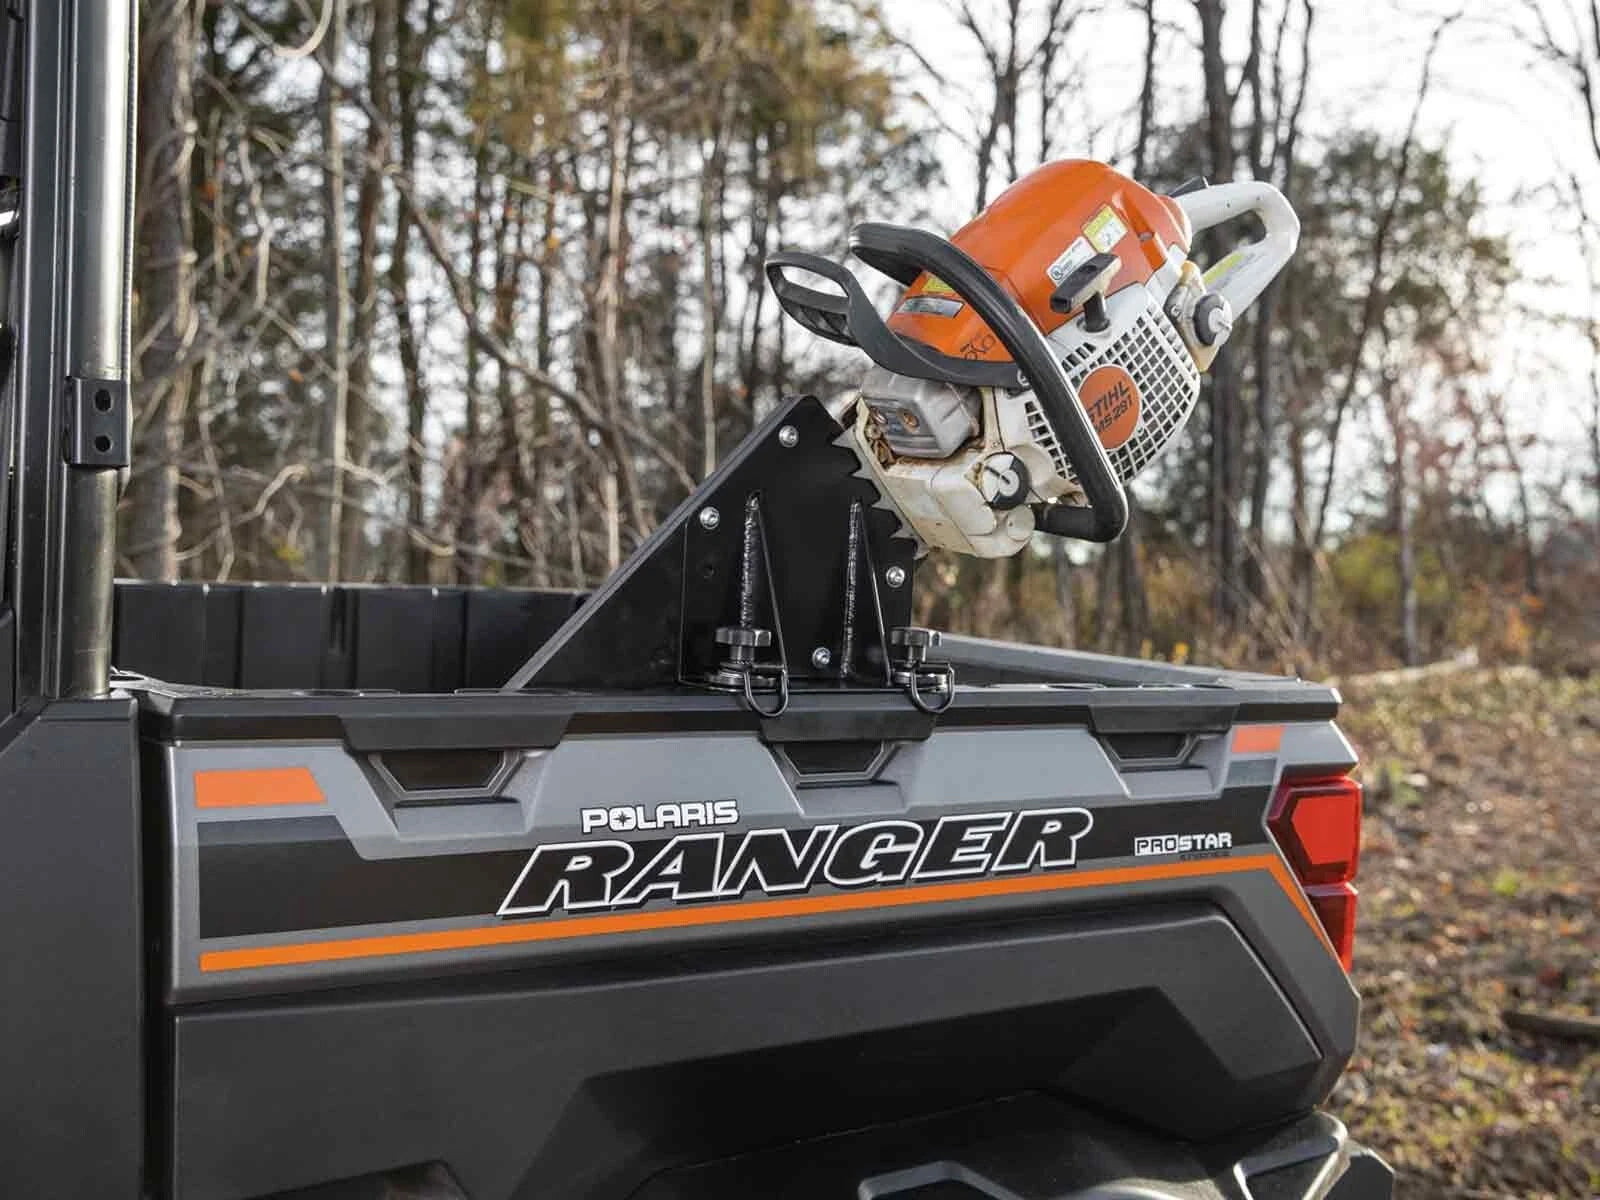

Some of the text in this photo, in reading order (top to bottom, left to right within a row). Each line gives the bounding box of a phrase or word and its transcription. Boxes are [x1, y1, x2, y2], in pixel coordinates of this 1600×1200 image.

[1086, 381, 1130, 423] STIHL
[581, 799, 739, 834] POLARIS
[496, 807, 1094, 917] RANGER
[1134, 831, 1232, 857] PROSTAR
